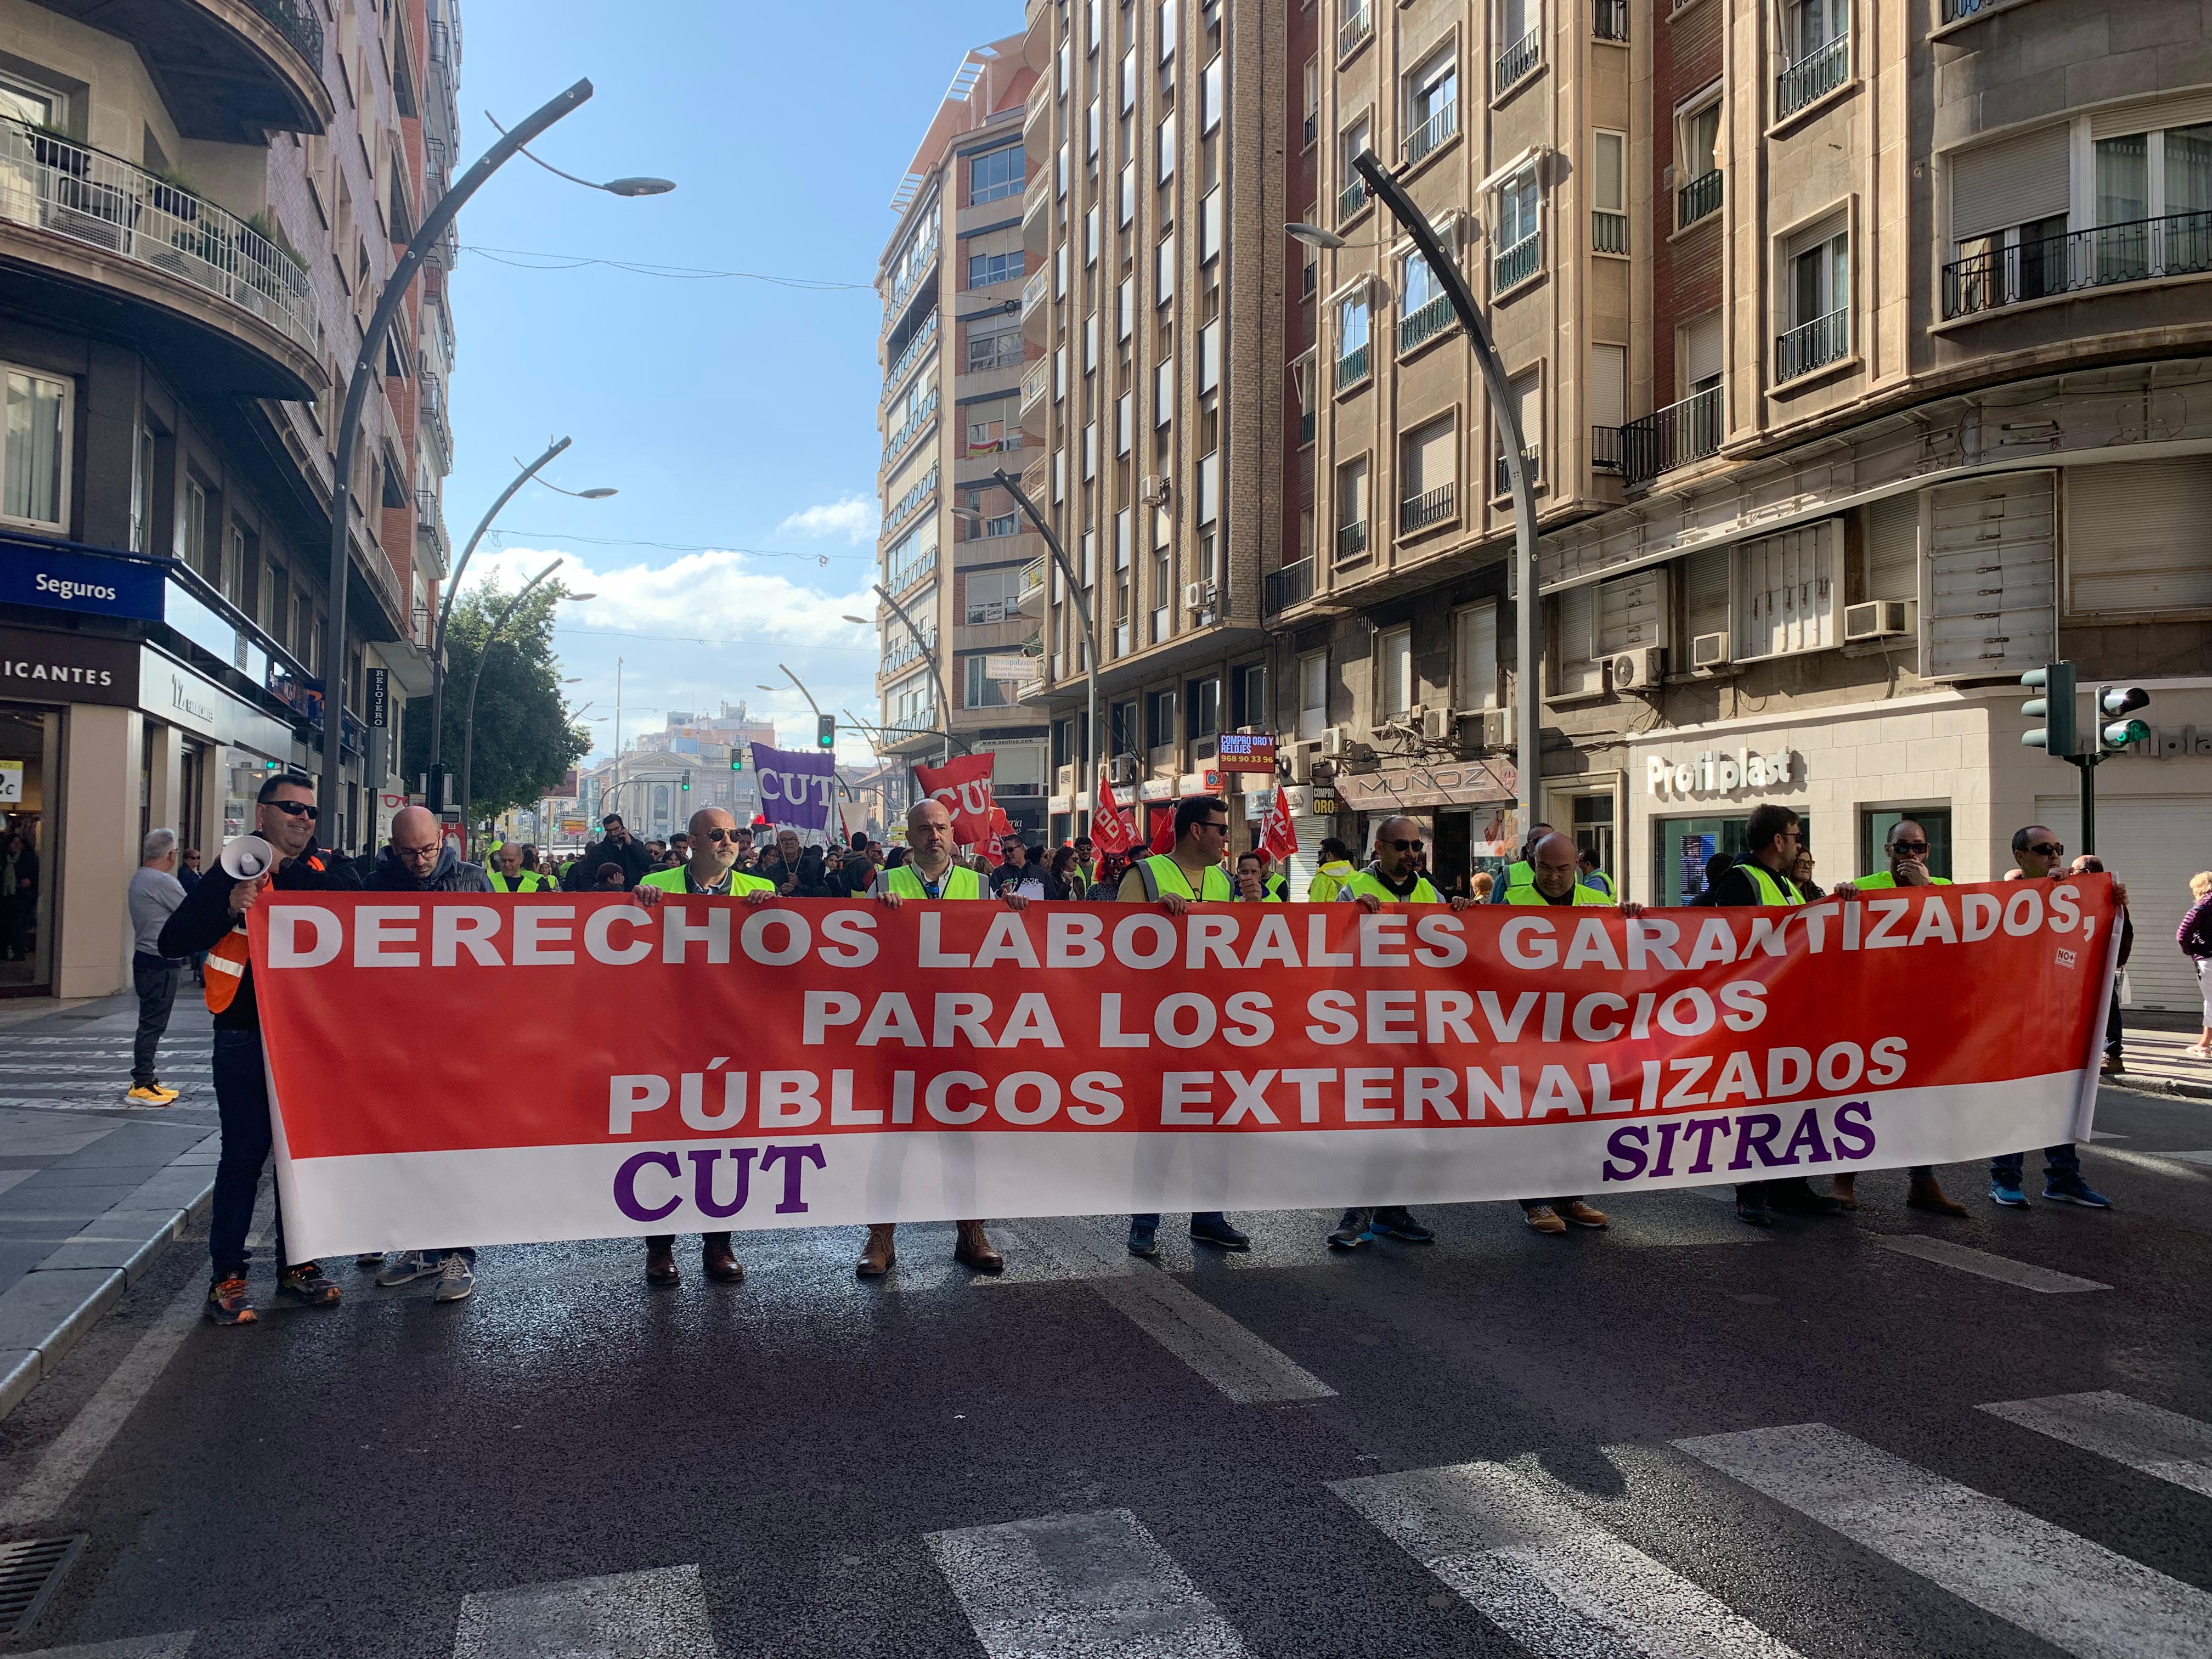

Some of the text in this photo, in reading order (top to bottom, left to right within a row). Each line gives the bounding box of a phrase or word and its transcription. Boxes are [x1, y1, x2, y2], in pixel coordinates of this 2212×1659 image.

[36, 573, 116, 600] Seguros
[0, 661, 112, 686] ICANTES
[374, 669, 384, 726] RELOJERO
[1221, 735, 1273, 746] COMPRO ORO Y
[1221, 744, 1251, 754] RELOJES
[1358, 766, 1486, 796] MUÑOZ
[1647, 746, 1790, 794] Profilplast
[757, 768, 833, 807] CUT
[1313, 788, 1335, 798] COMPRO
[1313, 799, 1334, 814] ORO
[267, 884, 2096, 971] DERECHOS LABORALES GARANTIZADOS,
[2058, 950, 2074, 961] NO+
[803, 980, 1768, 1049] PARA LOS SERVICIOS
[608, 1036, 1908, 1135] PÚBLICOS EXTERNALIZADOS
[1602, 1101, 1877, 1183] SITRAS
[613, 1143, 827, 1222] CUT
